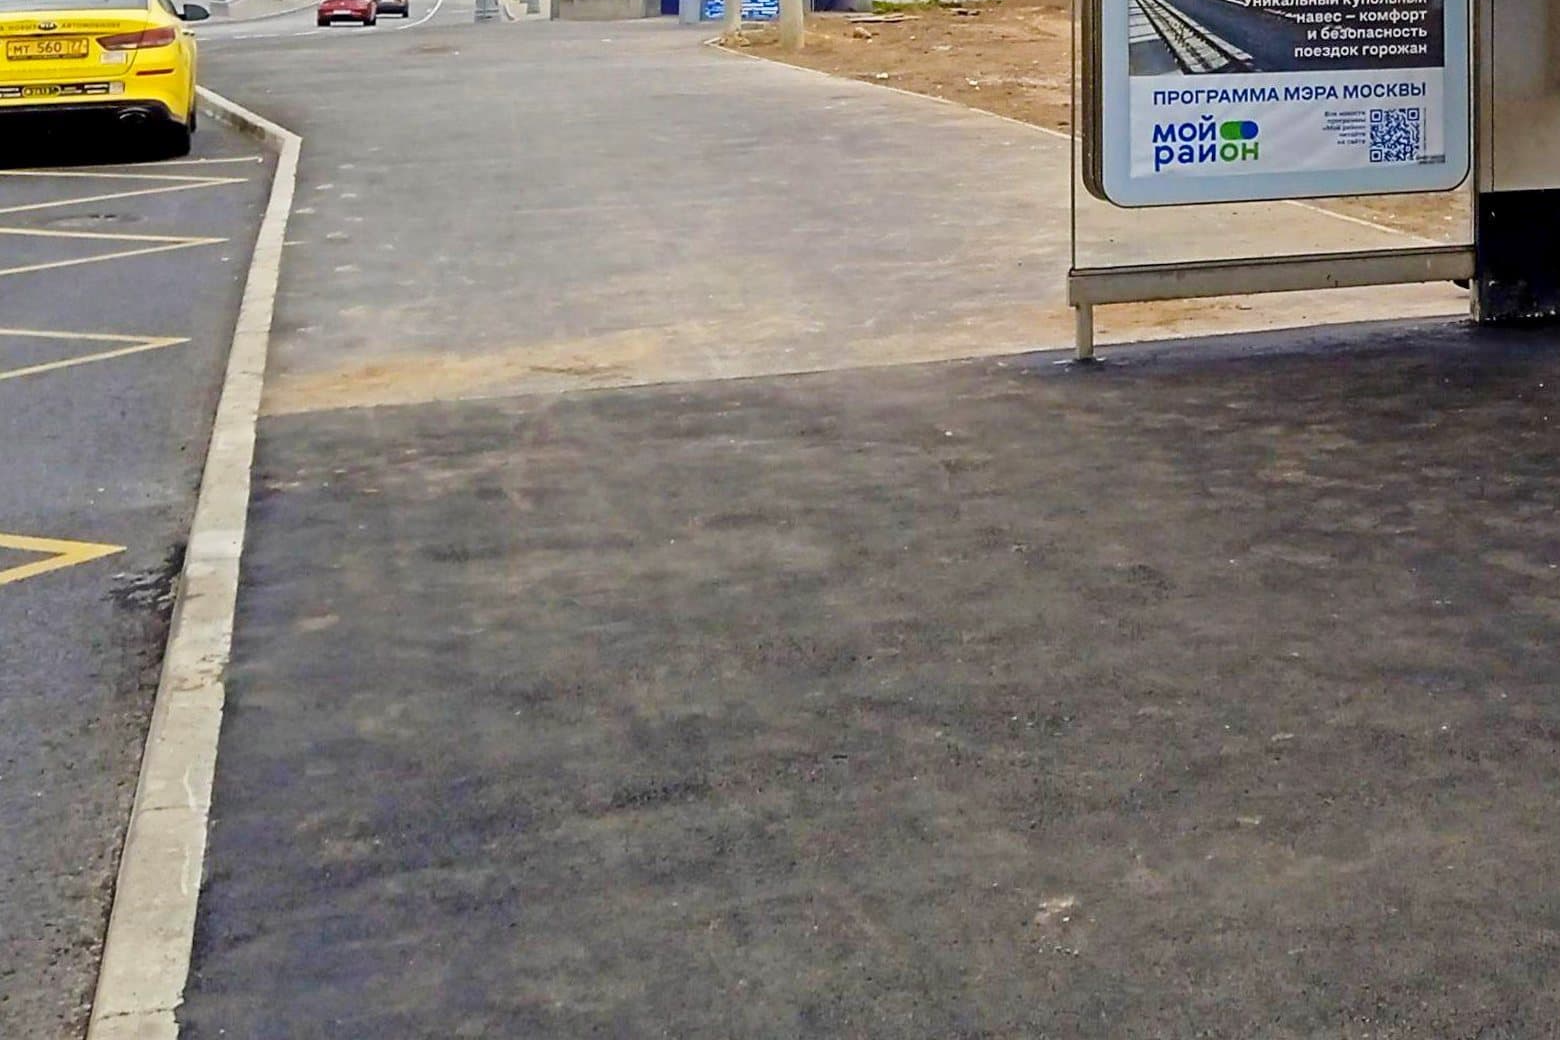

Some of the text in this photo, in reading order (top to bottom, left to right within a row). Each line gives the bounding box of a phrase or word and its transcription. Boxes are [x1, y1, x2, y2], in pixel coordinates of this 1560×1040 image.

[1296, 12, 1342, 23] навес
[1359, 9, 1428, 26] комфорт
[1307, 27, 1428, 40] и безопасность
[37, 41, 62, 53] 560
[1294, 44, 1428, 58] поездок горожан
[1153, 82, 1426, 105] ПРОГРАММА МЭРА МОСКВЫ
[1152, 115, 1216, 143] мой
